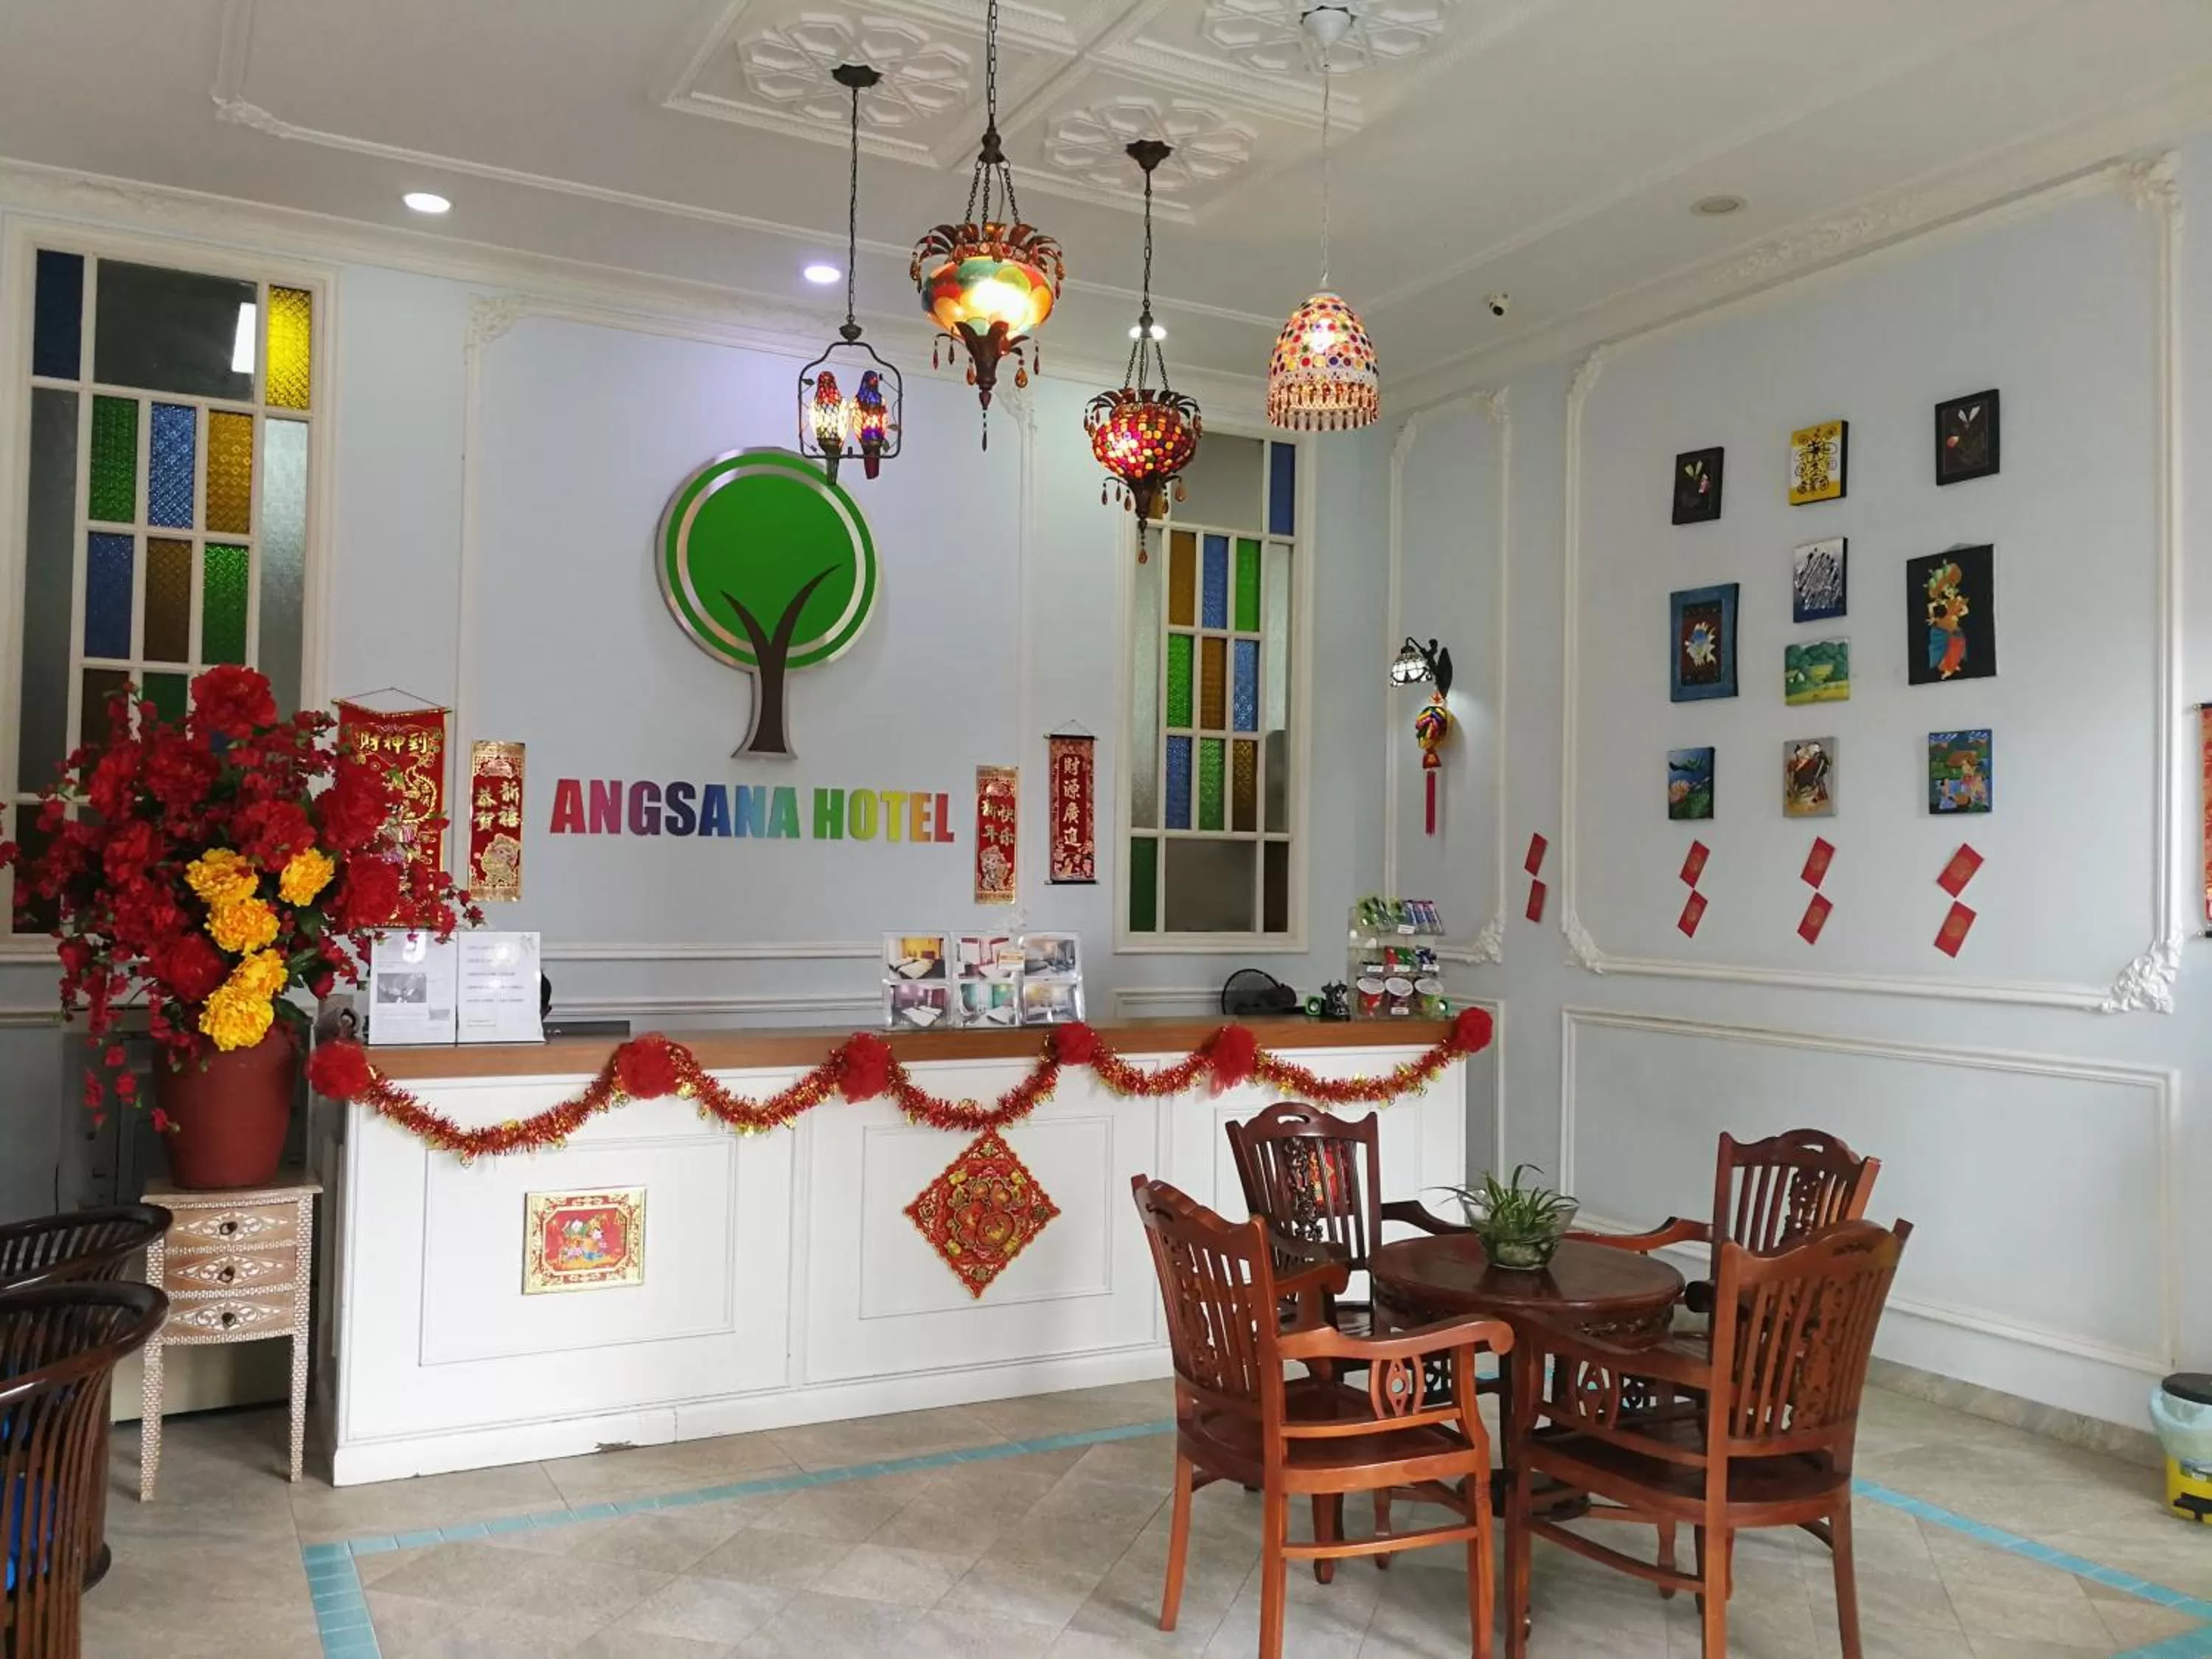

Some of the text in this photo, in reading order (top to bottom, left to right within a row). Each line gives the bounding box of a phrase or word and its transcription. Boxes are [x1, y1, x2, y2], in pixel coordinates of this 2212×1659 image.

[360, 731, 428, 754] 財神到
[549, 778, 956, 844] ANGSANA HOTEL
[1062, 756, 1082, 848] 財源廣進
